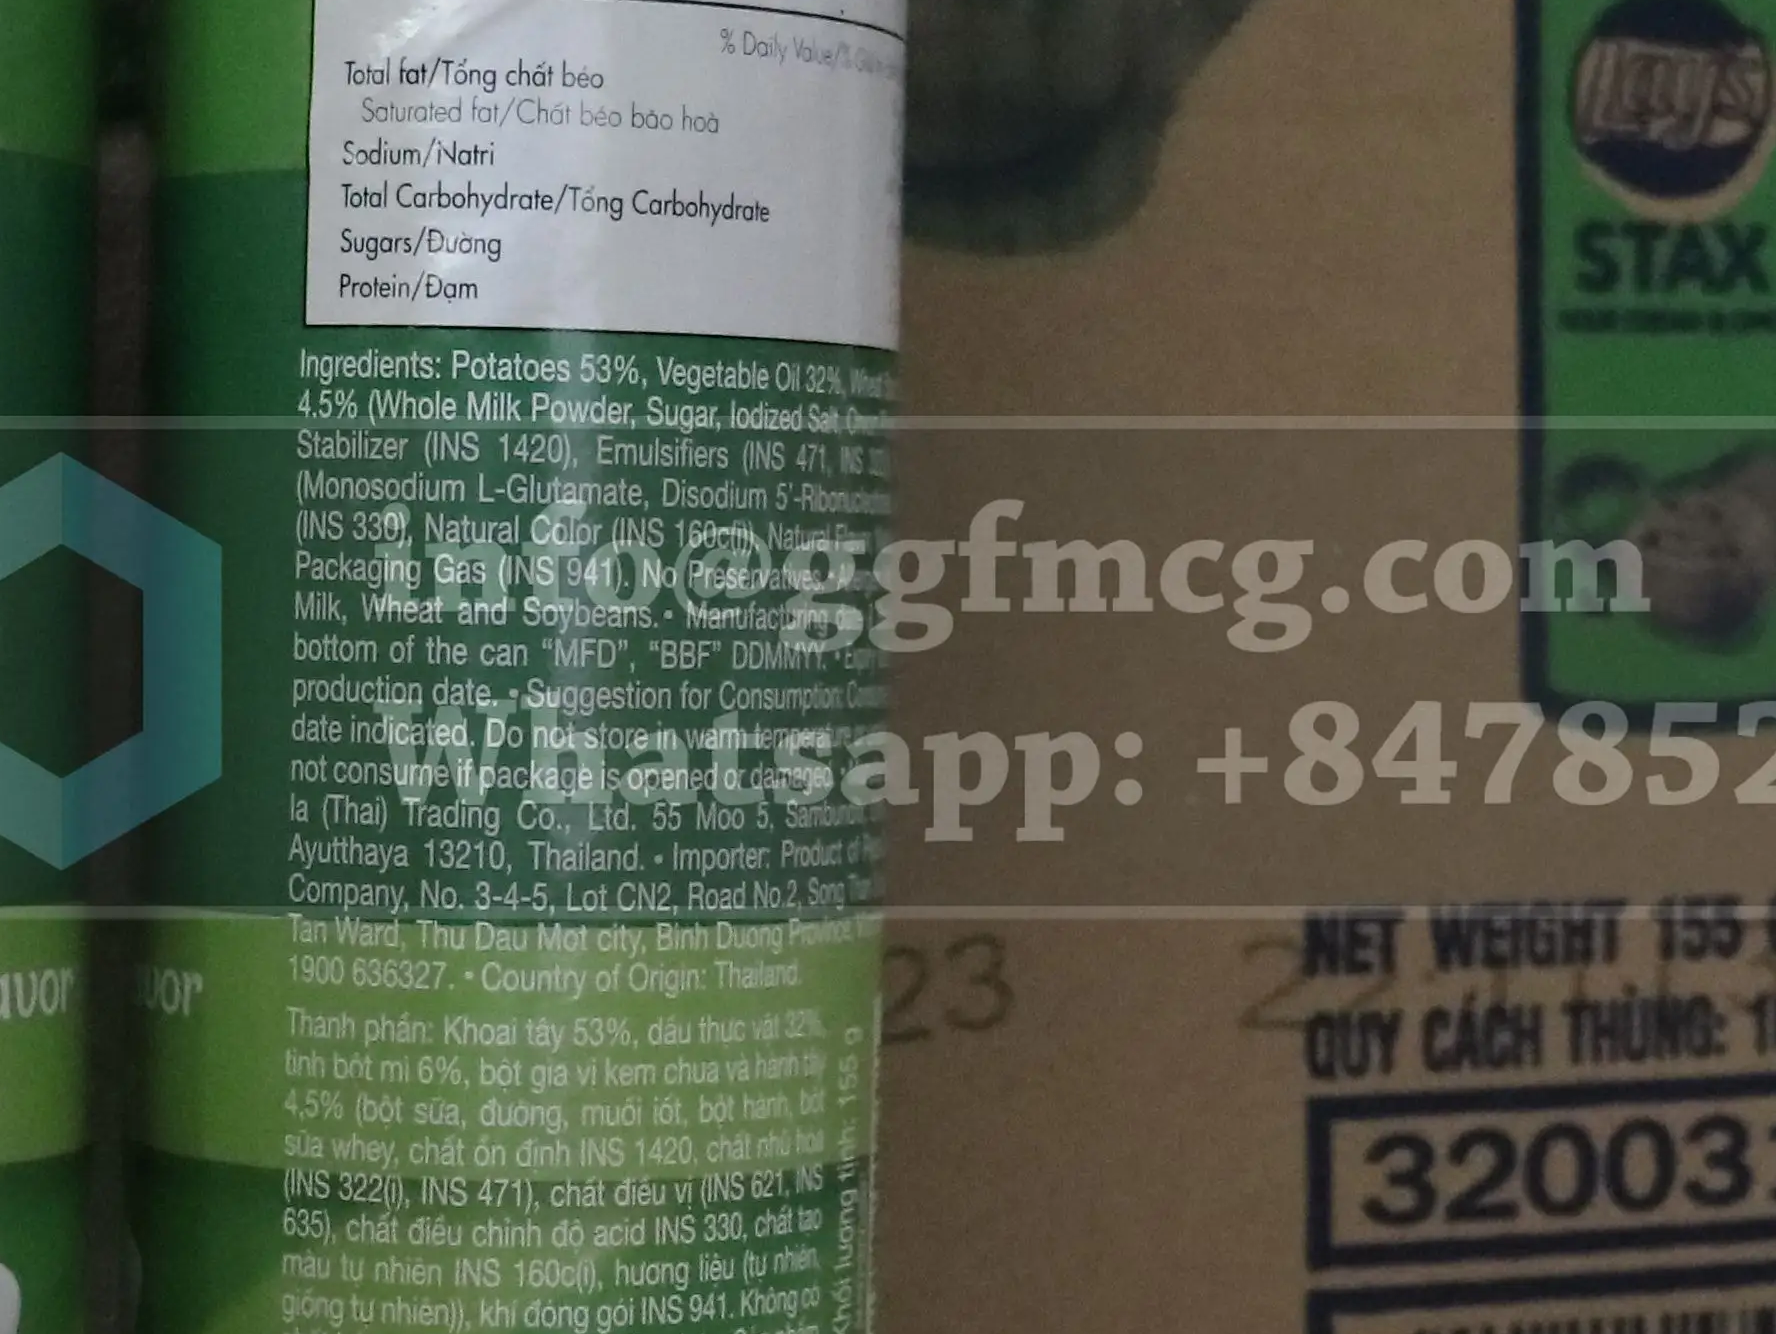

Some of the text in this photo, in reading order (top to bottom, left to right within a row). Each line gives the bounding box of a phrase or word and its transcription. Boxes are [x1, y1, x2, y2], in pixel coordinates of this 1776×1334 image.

[720, 27, 736, 55] %
[742, 30, 787, 64] Daily
[344, 58, 390, 87] Total
[506, 58, 554, 89] chất
[562, 60, 604, 90] béo
[362, 95, 462, 125] Saturated
[580, 100, 622, 130] béo
[343, 136, 496, 168] Sodium/Natri
[341, 180, 388, 209] Total
[632, 188, 771, 227] Carbohydrate
[1576, 220, 1770, 294] STAX
[339, 269, 478, 304] Protein/Đạm
[298, 347, 800, 395] Ingredients: Potatoes 53%, Vegetable Oil
[297, 388, 801, 435] 4.5% (Whole Milk Powder, Sugar, Iodized
[297, 429, 729, 469] Stabilizer (INS 1420), Emulsifiers
[296, 469, 767, 512] (Monosodium L-Glutamate, Disodium
[1305, 910, 1404, 978] NET
[1429, 898, 1626, 971] WEIGHT
[1655, 895, 1742, 961] 155
[1305, 1008, 1403, 1080] QUY
